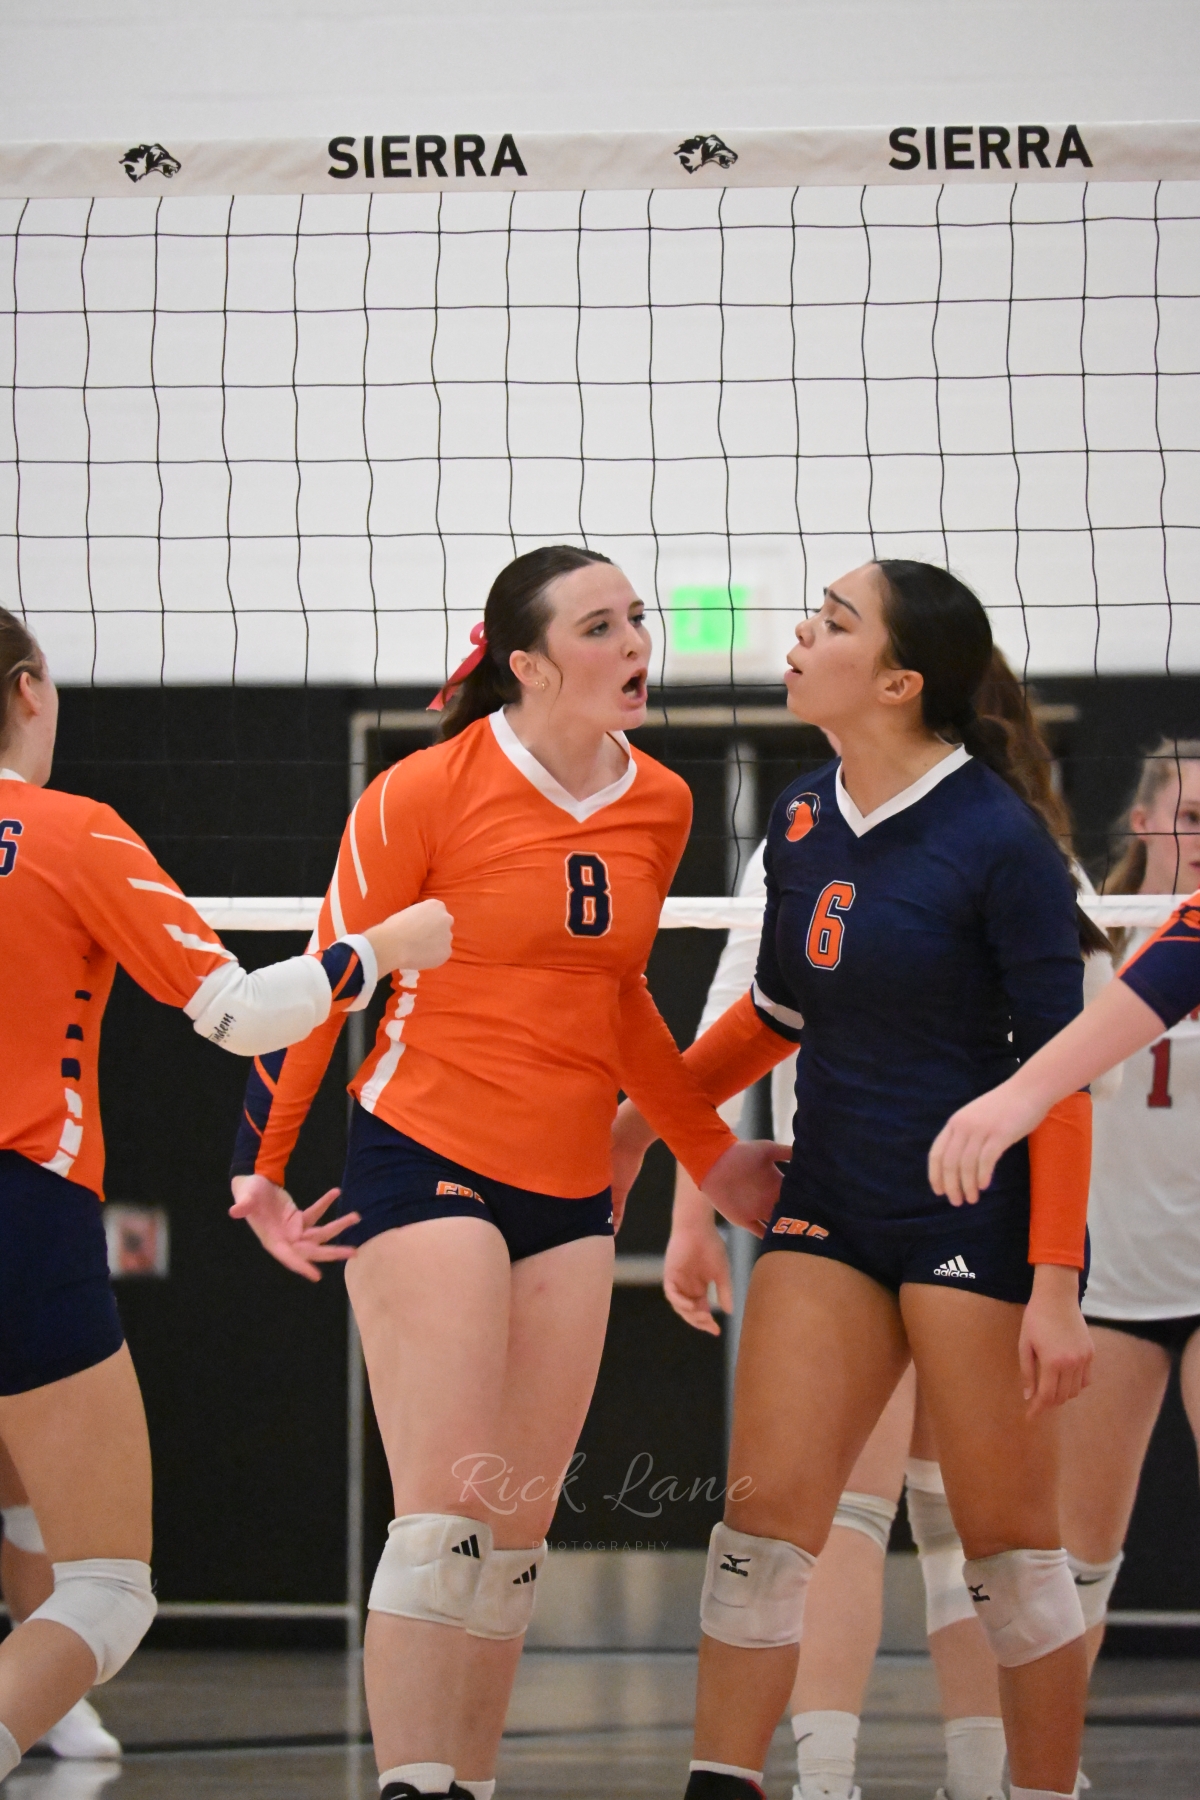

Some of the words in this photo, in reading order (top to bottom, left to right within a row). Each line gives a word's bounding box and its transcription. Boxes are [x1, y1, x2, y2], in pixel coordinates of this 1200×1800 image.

[328, 134, 528, 179] SIERRA
[889, 124, 1094, 170] SIERRA
[565, 851, 612, 938] 8
[806, 880, 856, 970] 6
[1147, 1038, 1172, 1108] 1
[933, 1268, 976, 1279] adidas
